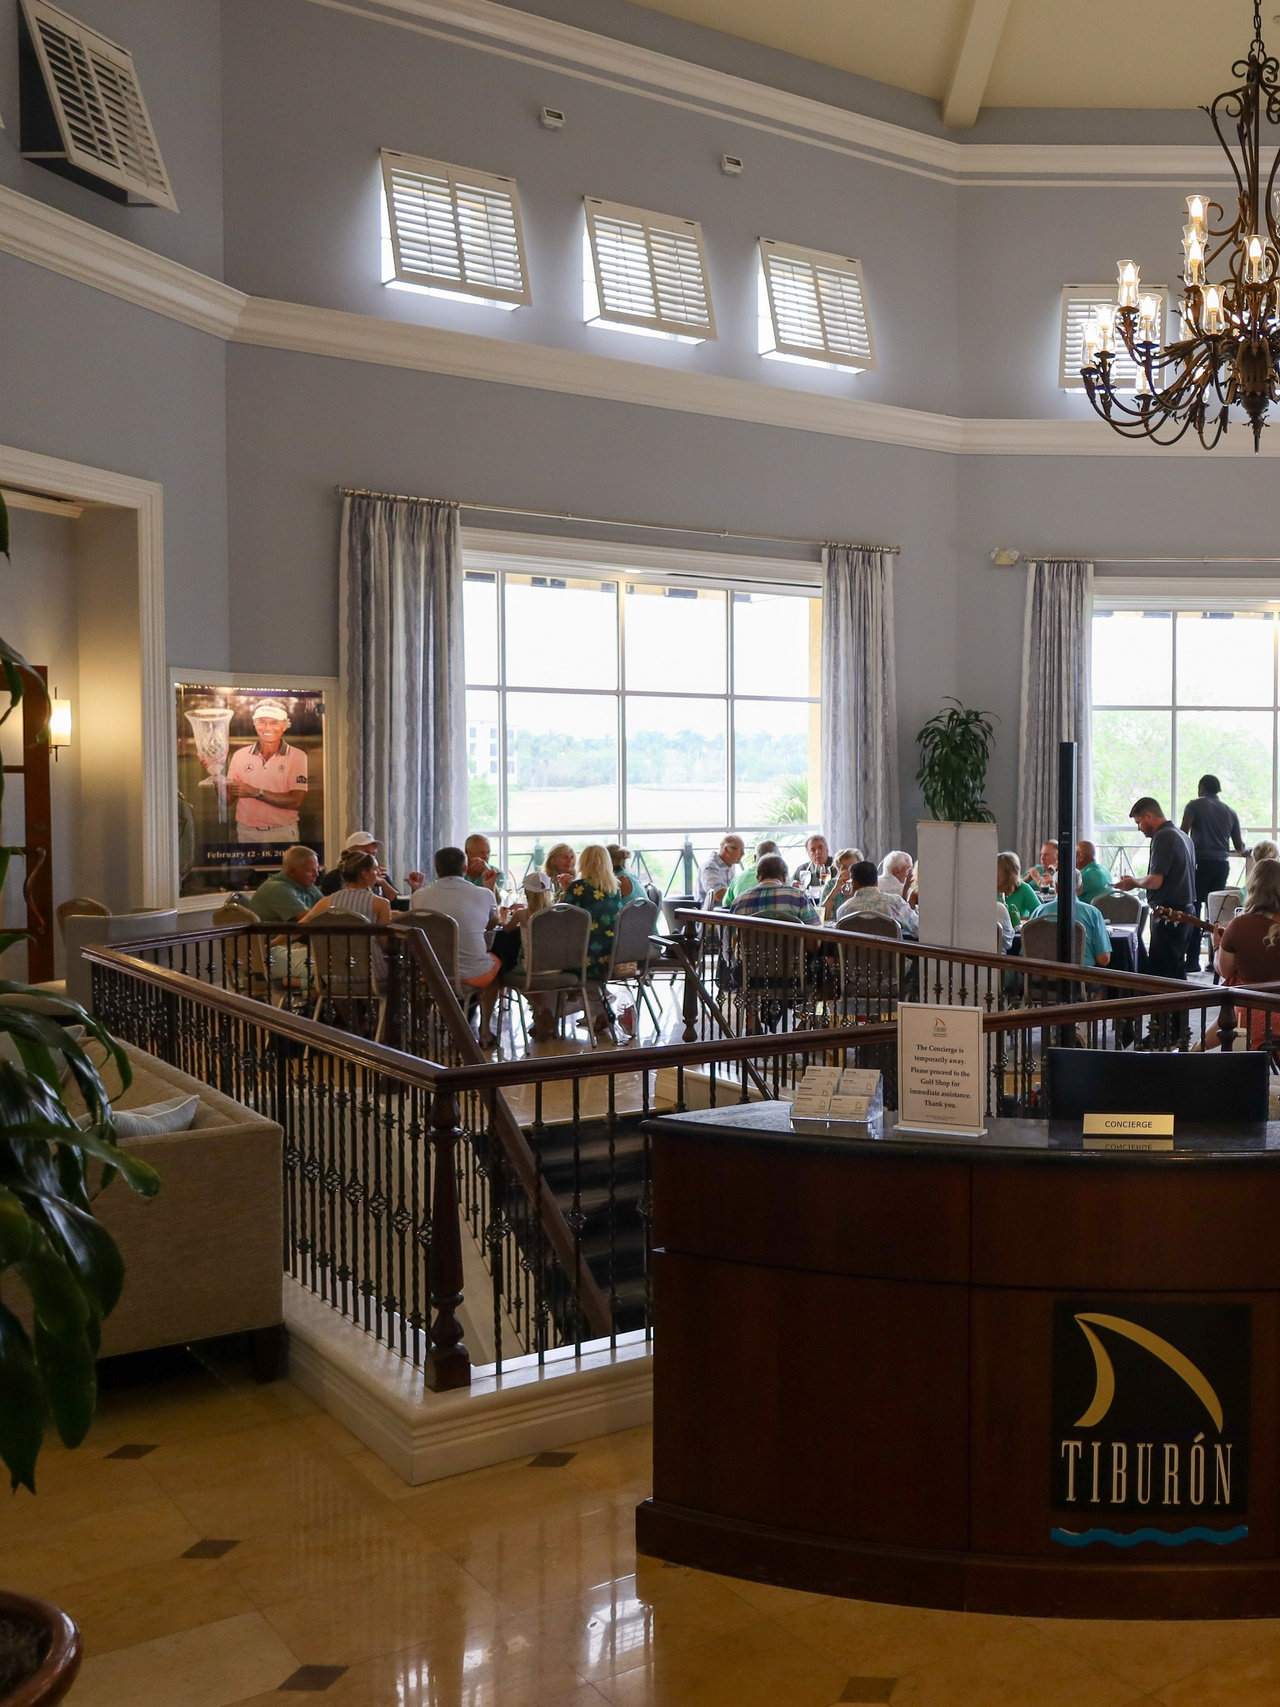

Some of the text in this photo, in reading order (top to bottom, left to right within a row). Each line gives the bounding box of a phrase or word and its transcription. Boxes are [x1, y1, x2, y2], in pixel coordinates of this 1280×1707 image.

[207, 851, 246, 859] February
[247, 850, 256, 858] 12
[929, 1045, 957, 1054] Concierge
[914, 1055, 948, 1064] temporarily
[935, 1079, 951, 1088] Shop
[910, 1088, 972, 1099] immediate assistance.
[924, 1099, 943, 1107] Thank
[1104, 1120, 1153, 1128] CONCIERGE
[1061, 1431, 1233, 1505] TIBURÓN
